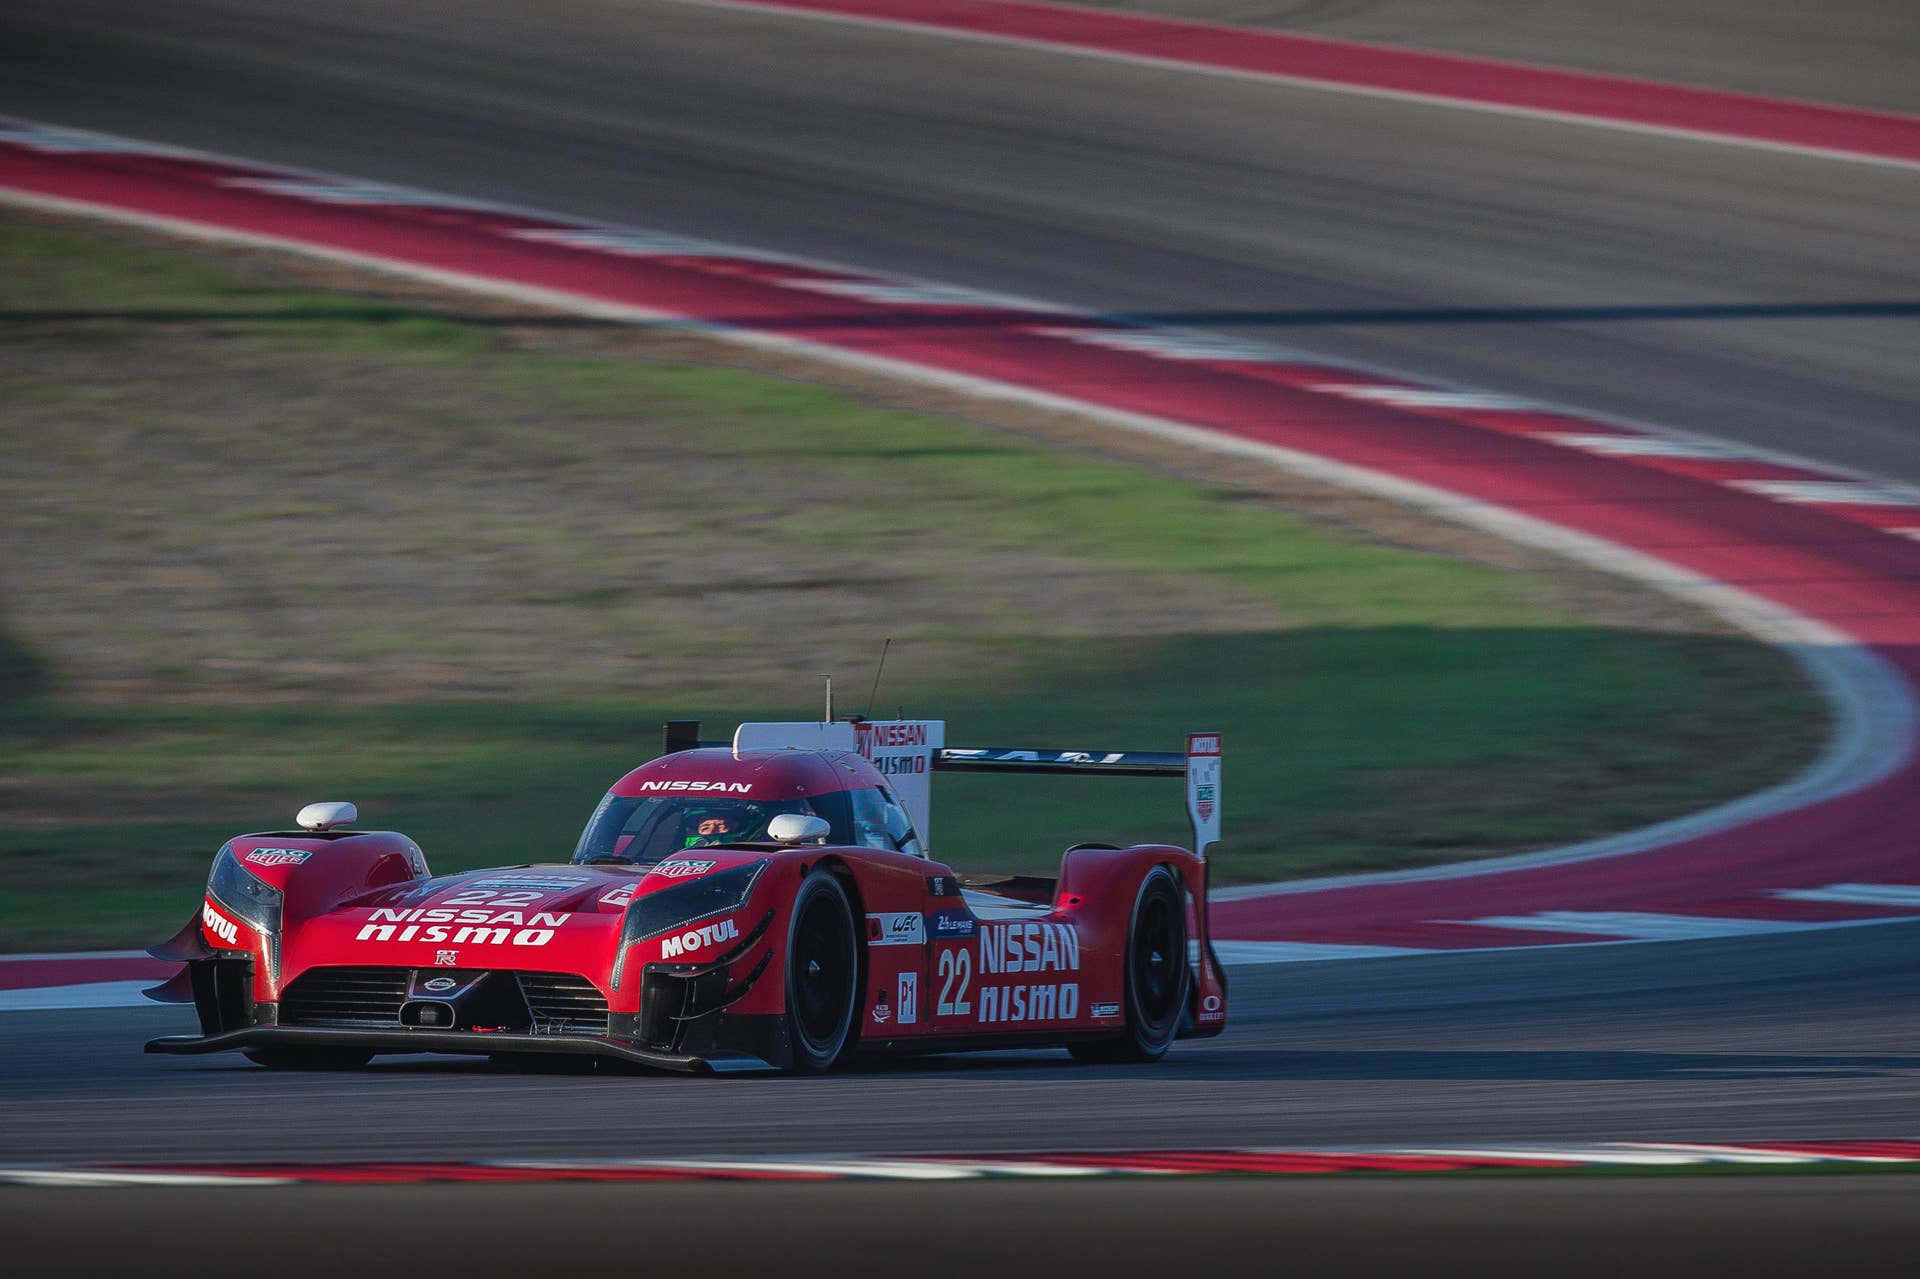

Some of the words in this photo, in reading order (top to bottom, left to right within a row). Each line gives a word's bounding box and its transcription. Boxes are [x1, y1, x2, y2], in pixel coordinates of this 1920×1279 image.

[873, 725, 927, 746] NISSAN
[640, 781, 752, 793] NISSAN
[248, 853, 303, 864] HEUER
[654, 866, 708, 875] HEUER
[440, 890, 544, 907] 22
[367, 909, 571, 927] NISSAN
[355, 924, 555, 946] nismo
[662, 919, 739, 959] MOTUL
[979, 924, 1080, 974] NISSAN
[937, 948, 971, 1015] 22
[901, 980, 914, 1015] P1
[978, 984, 1079, 1022] nismo
